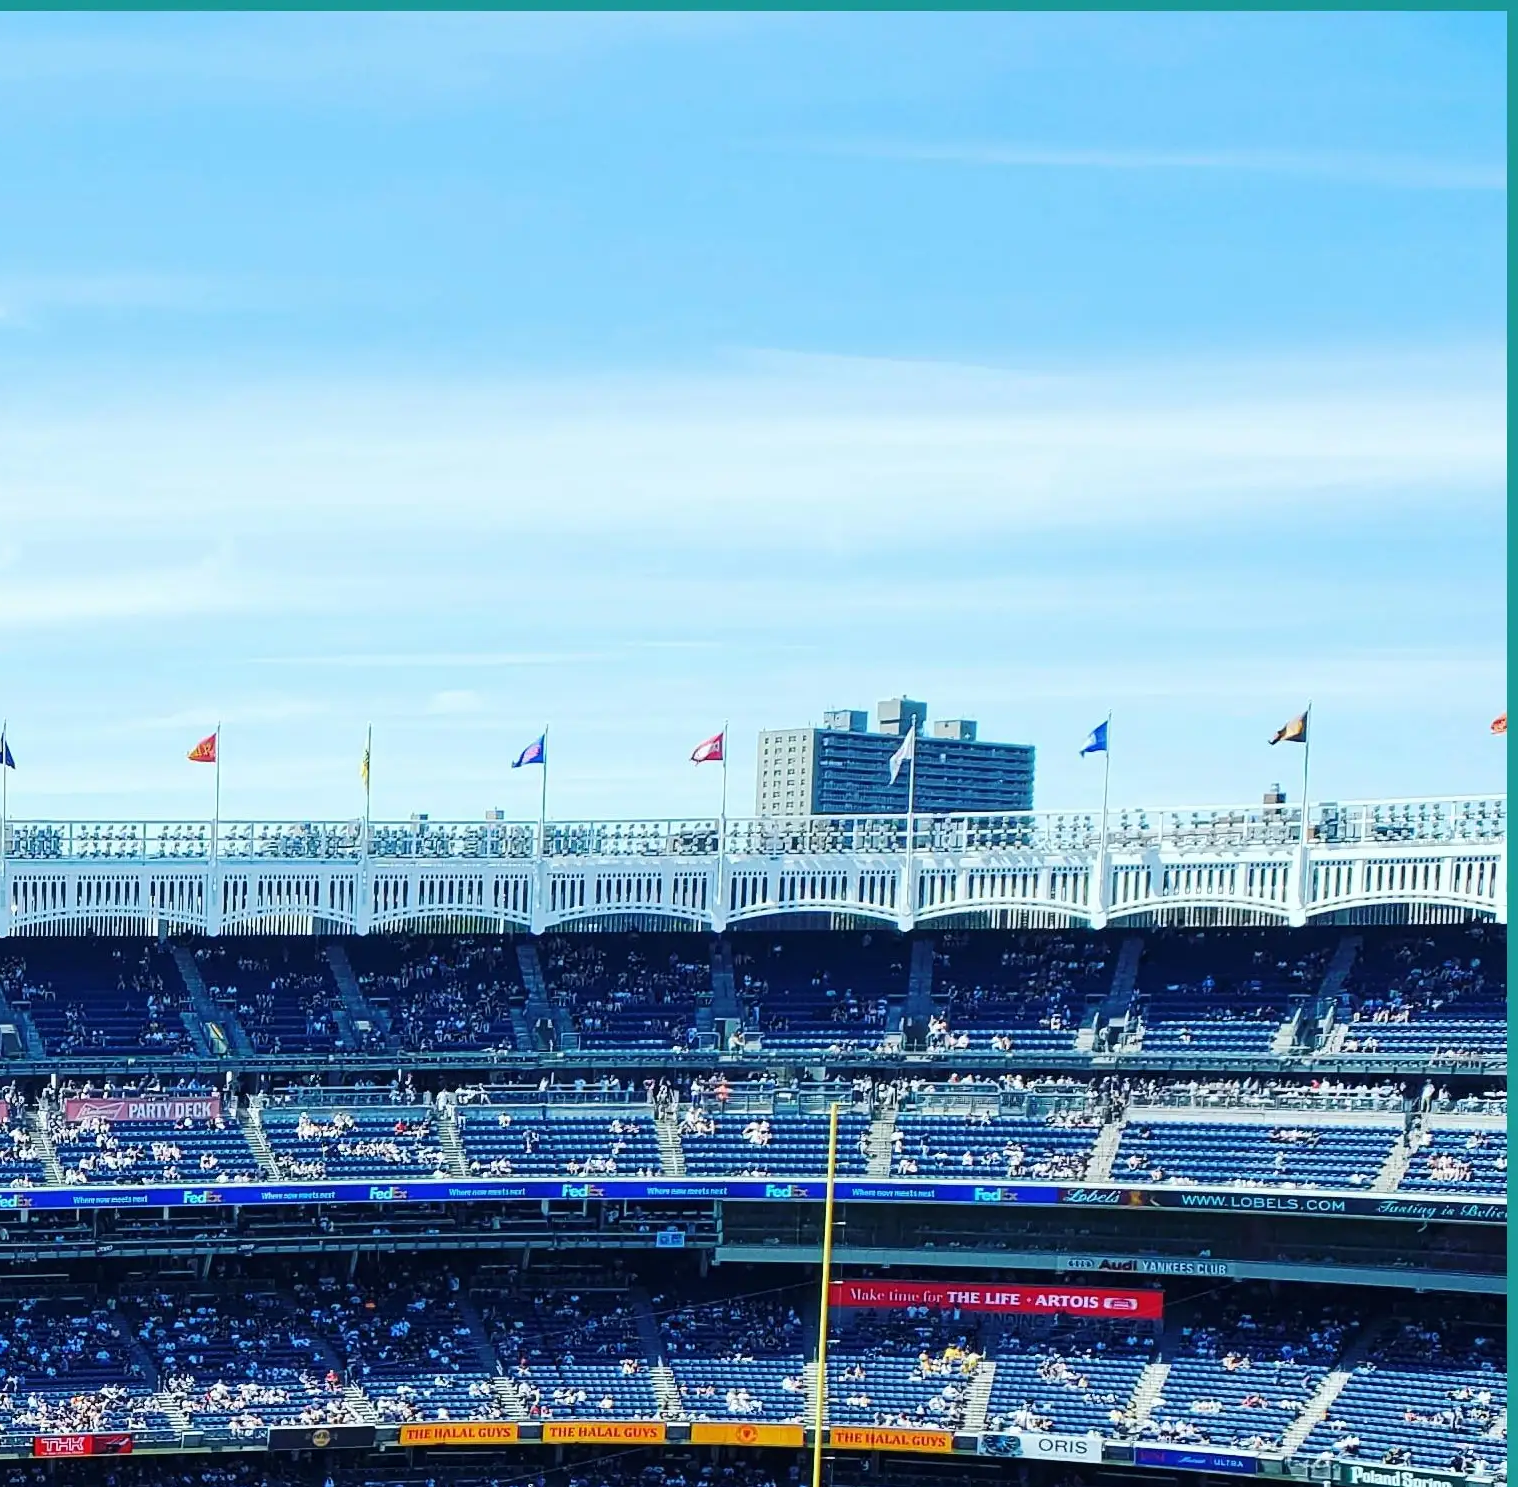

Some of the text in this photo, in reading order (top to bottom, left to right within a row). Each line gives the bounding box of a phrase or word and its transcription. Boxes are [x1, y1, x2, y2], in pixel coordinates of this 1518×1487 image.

[128, 1102, 212, 1119] PARTY DECK
[183, 1191, 222, 1204] FedEx
[369, 1187, 407, 1199] FedEx
[562, 1184, 604, 1197] FedEx
[766, 1185, 808, 1197] FedEx
[974, 1187, 1018, 1201] FedEx
[1181, 1194, 1345, 1212] WWW.LOBELS.COM
[1441, 1205, 1455, 1215] is
[1099, 1259, 1226, 1275] Audi YANKEES CLUB
[850, 1288, 885, 1301] Make
[889, 1289, 920, 1301] time
[923, 1290, 943, 1303] for
[947, 1291, 980, 1304] THE
[985, 1292, 1021, 1305] LIFE
[1035, 1294, 1099, 1309] ARTOIS
[407, 1427, 511, 1440] THE HALAL GUYS
[550, 1427, 657, 1438] THE HALAL GUYS
[835, 1432, 946, 1447] THE HALAL GUYS
[40, 1437, 85, 1452] THK
[1038, 1438, 1088, 1454] ORIS
[1213, 1458, 1243, 1468] ULTRA
[1350, 1466, 1400, 1484] Poland
